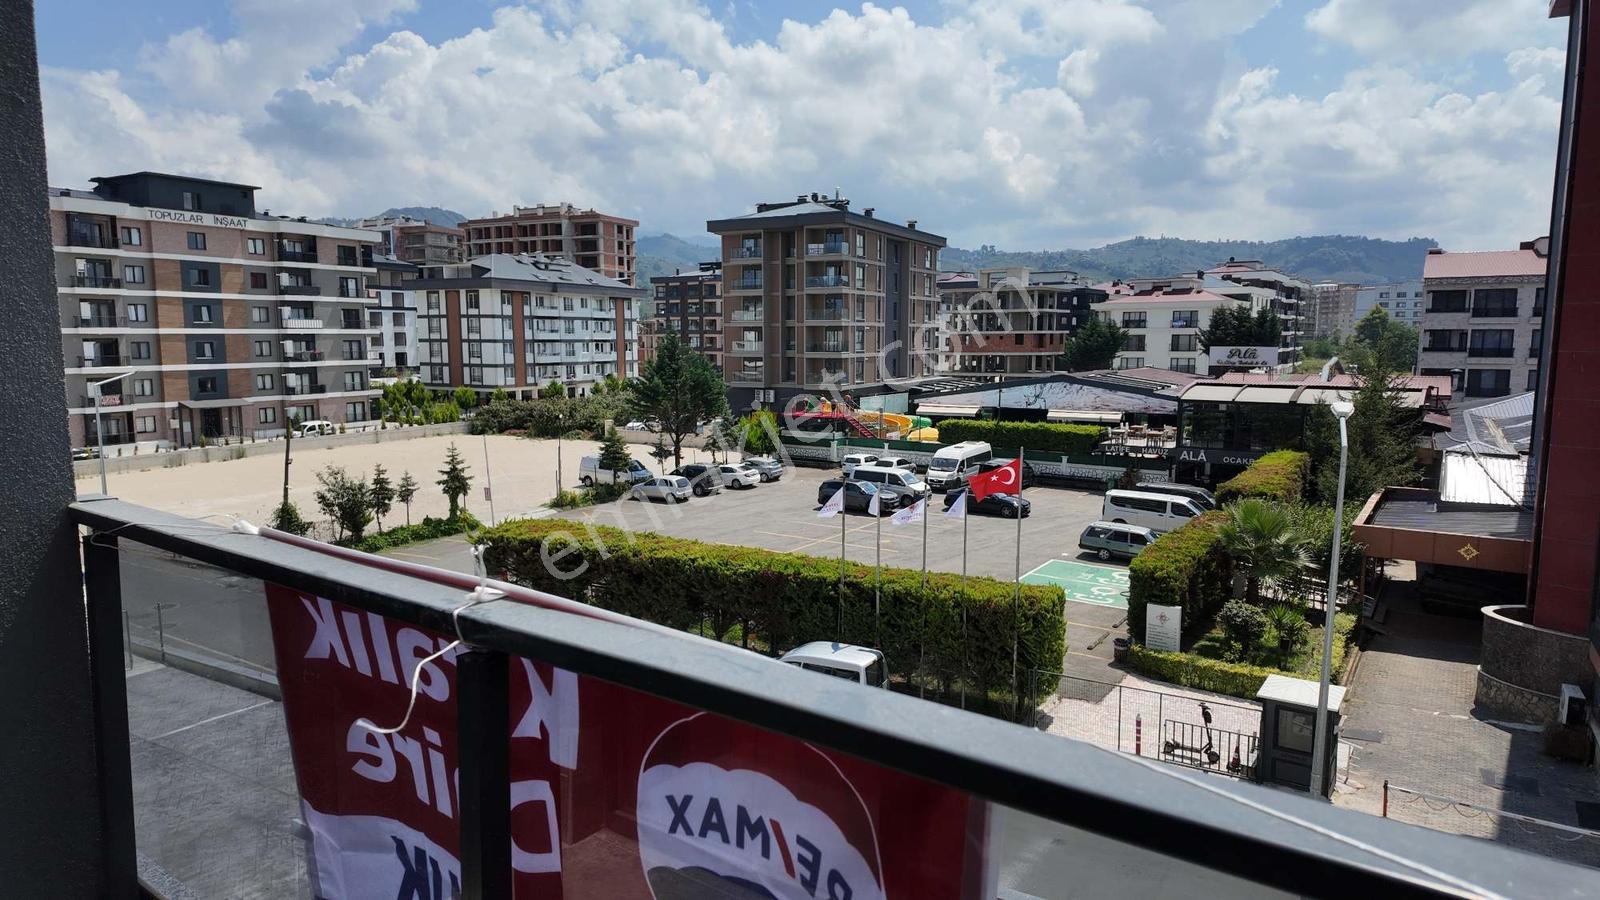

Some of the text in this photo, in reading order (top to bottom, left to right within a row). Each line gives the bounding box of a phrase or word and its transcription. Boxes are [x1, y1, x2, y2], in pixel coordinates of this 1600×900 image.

[148, 210, 249, 228] TOPUZLAR İNŞAAT
[1141, 447, 1169, 456] HAVUZ
[1223, 456, 1255, 465] OCAKB
